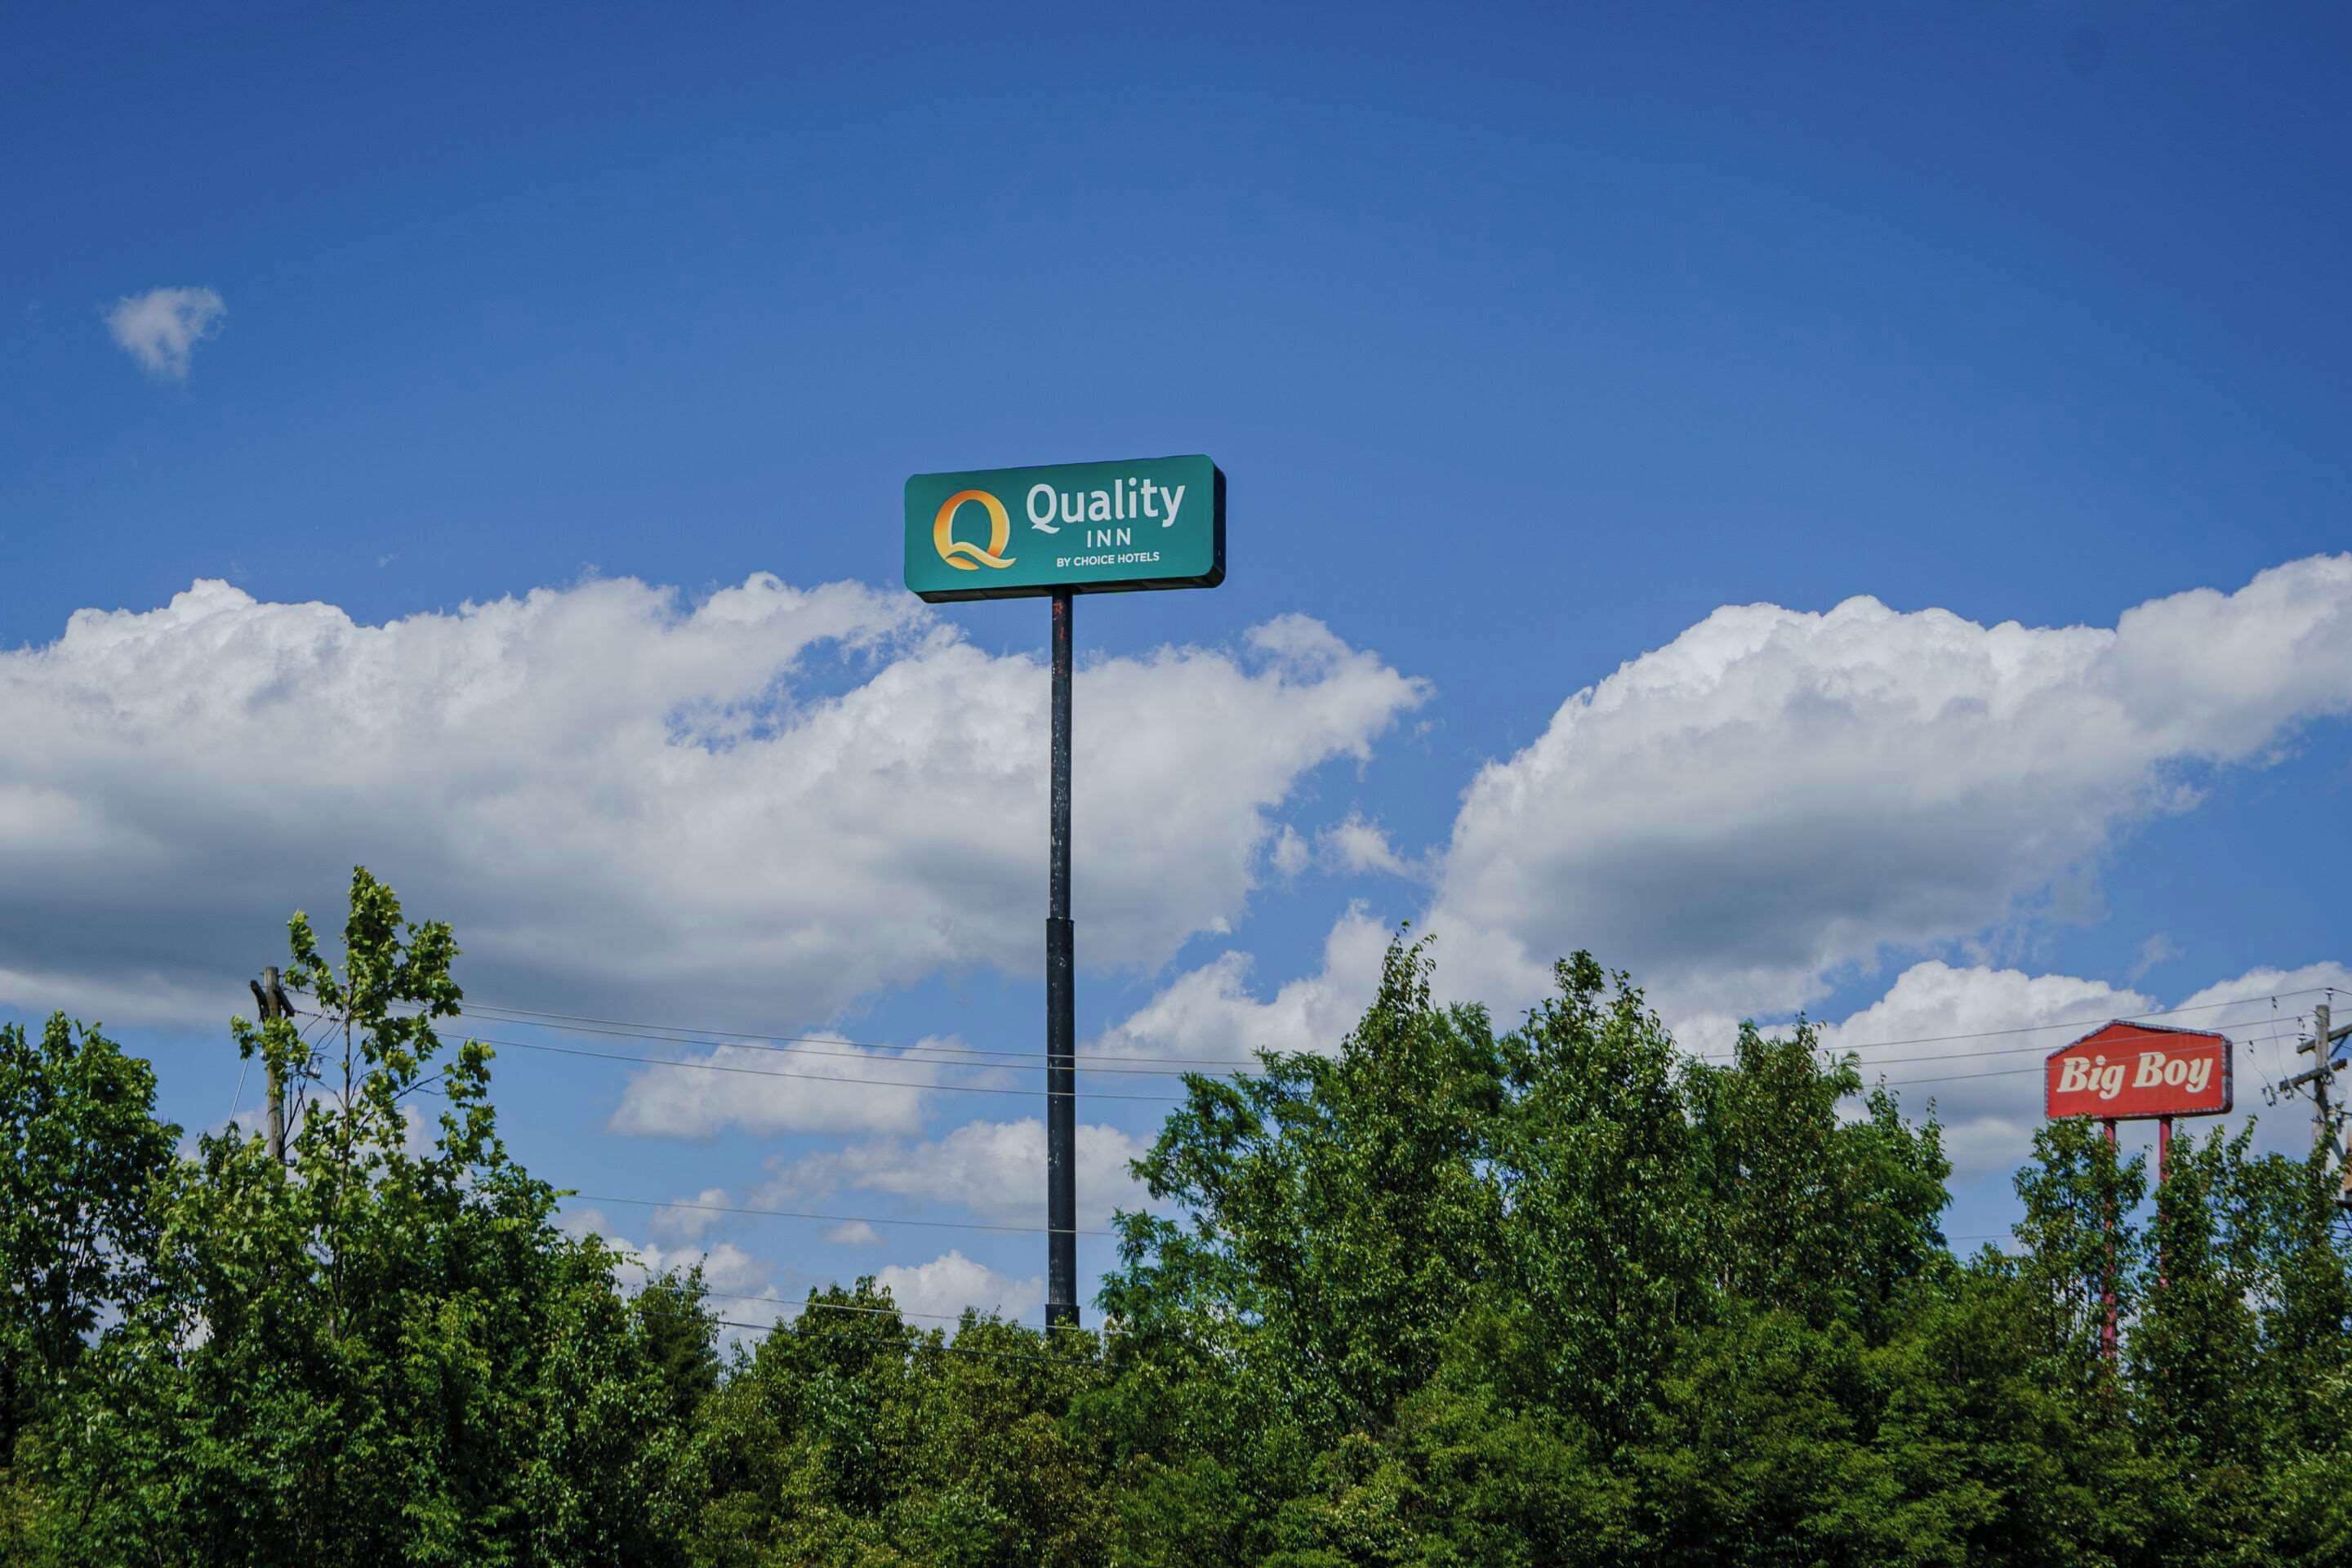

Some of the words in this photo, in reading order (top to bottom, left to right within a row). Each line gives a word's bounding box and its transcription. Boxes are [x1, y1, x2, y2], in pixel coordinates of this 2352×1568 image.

[933, 489, 1017, 570] Q
[1027, 477, 1186, 534] Quality
[1057, 557, 1071, 568] BY
[1073, 554, 1115, 567] CHOICE
[1117, 551, 1160, 564] HOTELS
[1086, 528, 1131, 548] INN
[2056, 1054, 2125, 1100] Big
[2132, 1051, 2213, 1093] Boy
